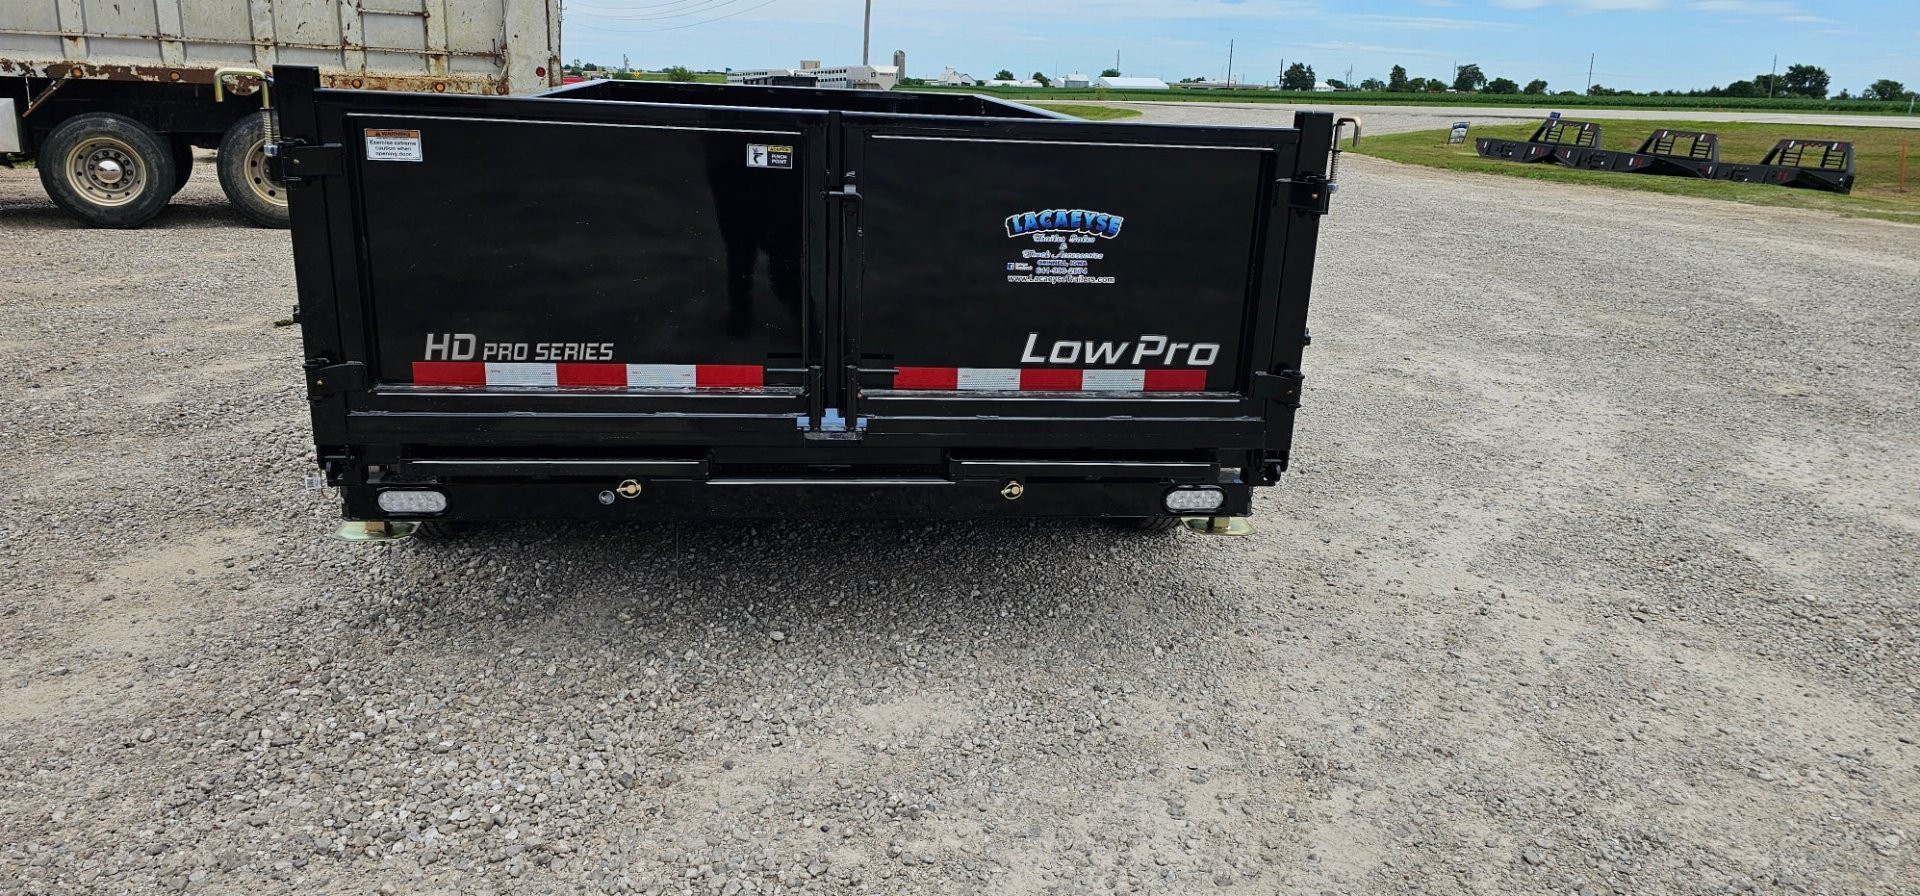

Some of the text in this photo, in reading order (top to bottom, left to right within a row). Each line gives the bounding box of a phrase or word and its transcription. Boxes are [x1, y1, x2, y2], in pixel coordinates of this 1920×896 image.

[1008, 209, 1123, 236] LACAEYSE
[1032, 233, 1096, 243] Trailer Sales
[1022, 249, 1051, 259] Truck
[424, 333, 614, 361] HD PRO SERIES
